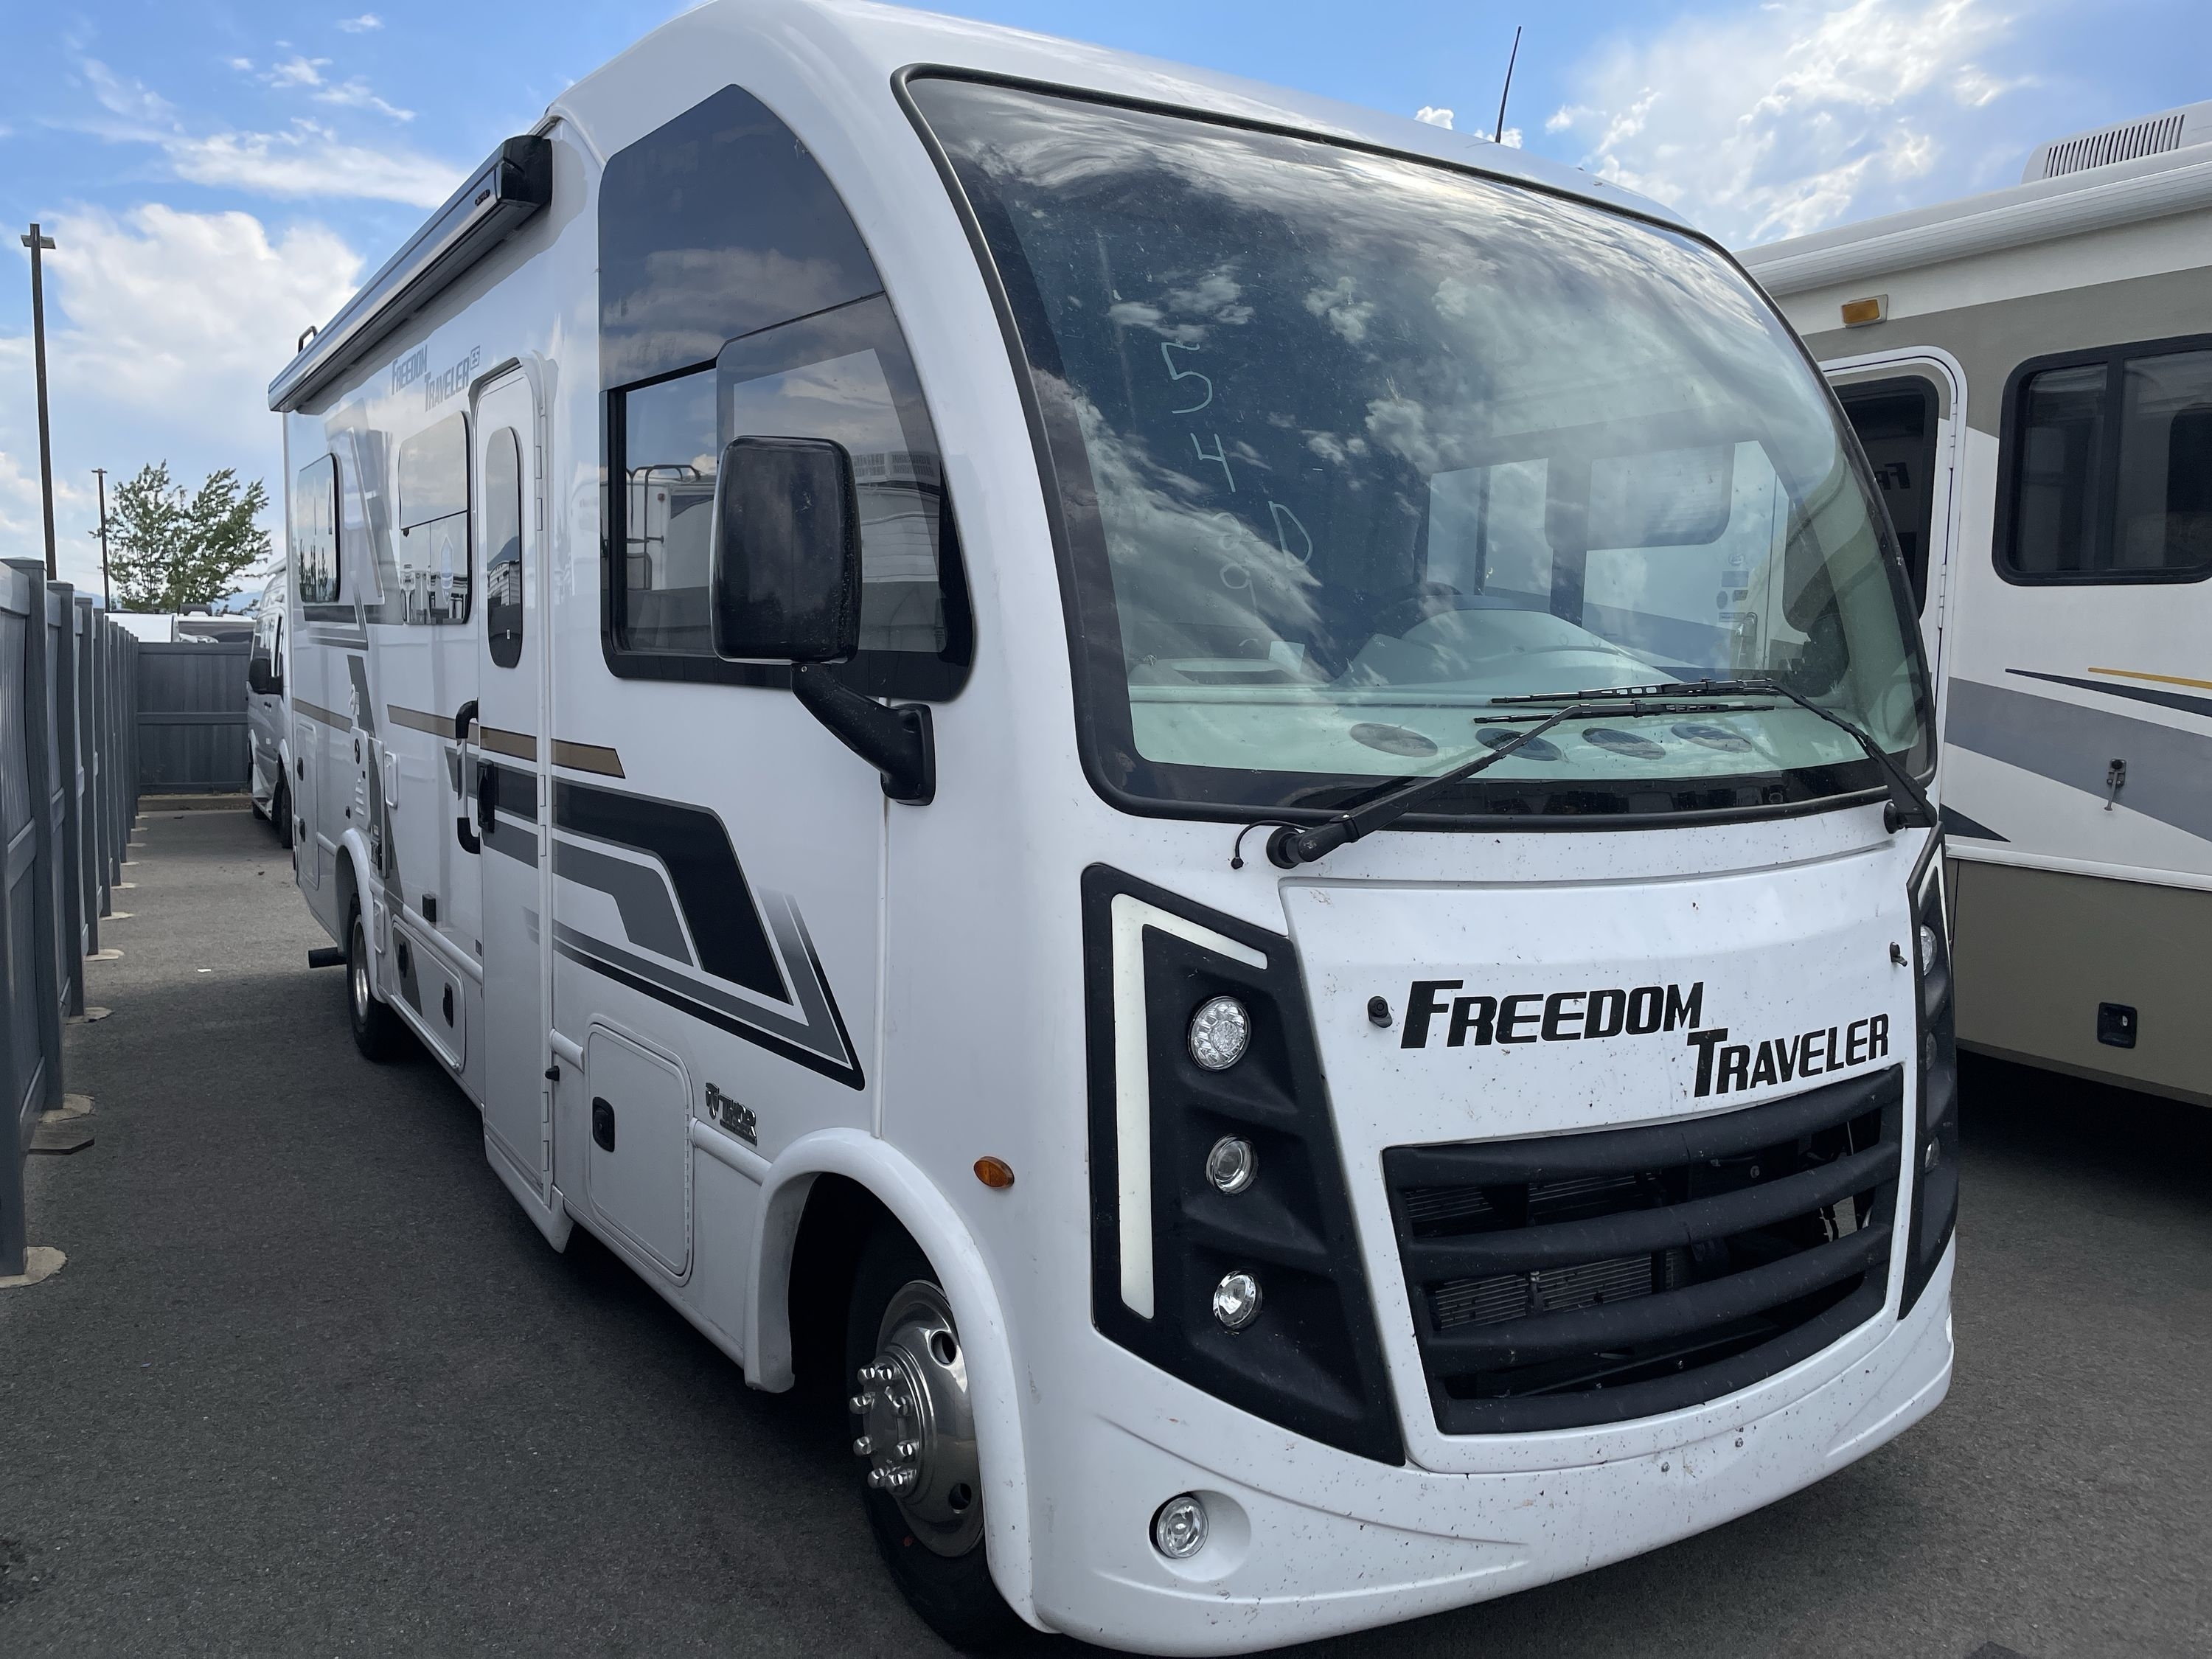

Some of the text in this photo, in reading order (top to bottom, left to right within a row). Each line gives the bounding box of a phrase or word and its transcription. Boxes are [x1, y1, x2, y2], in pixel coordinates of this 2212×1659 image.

[392, 344, 428, 395] FREEDOM
[425, 357, 470, 412] TRAVELER
[1400, 979, 1704, 1049] FREEDOM
[1687, 1012, 1890, 1098] TRAVELER
